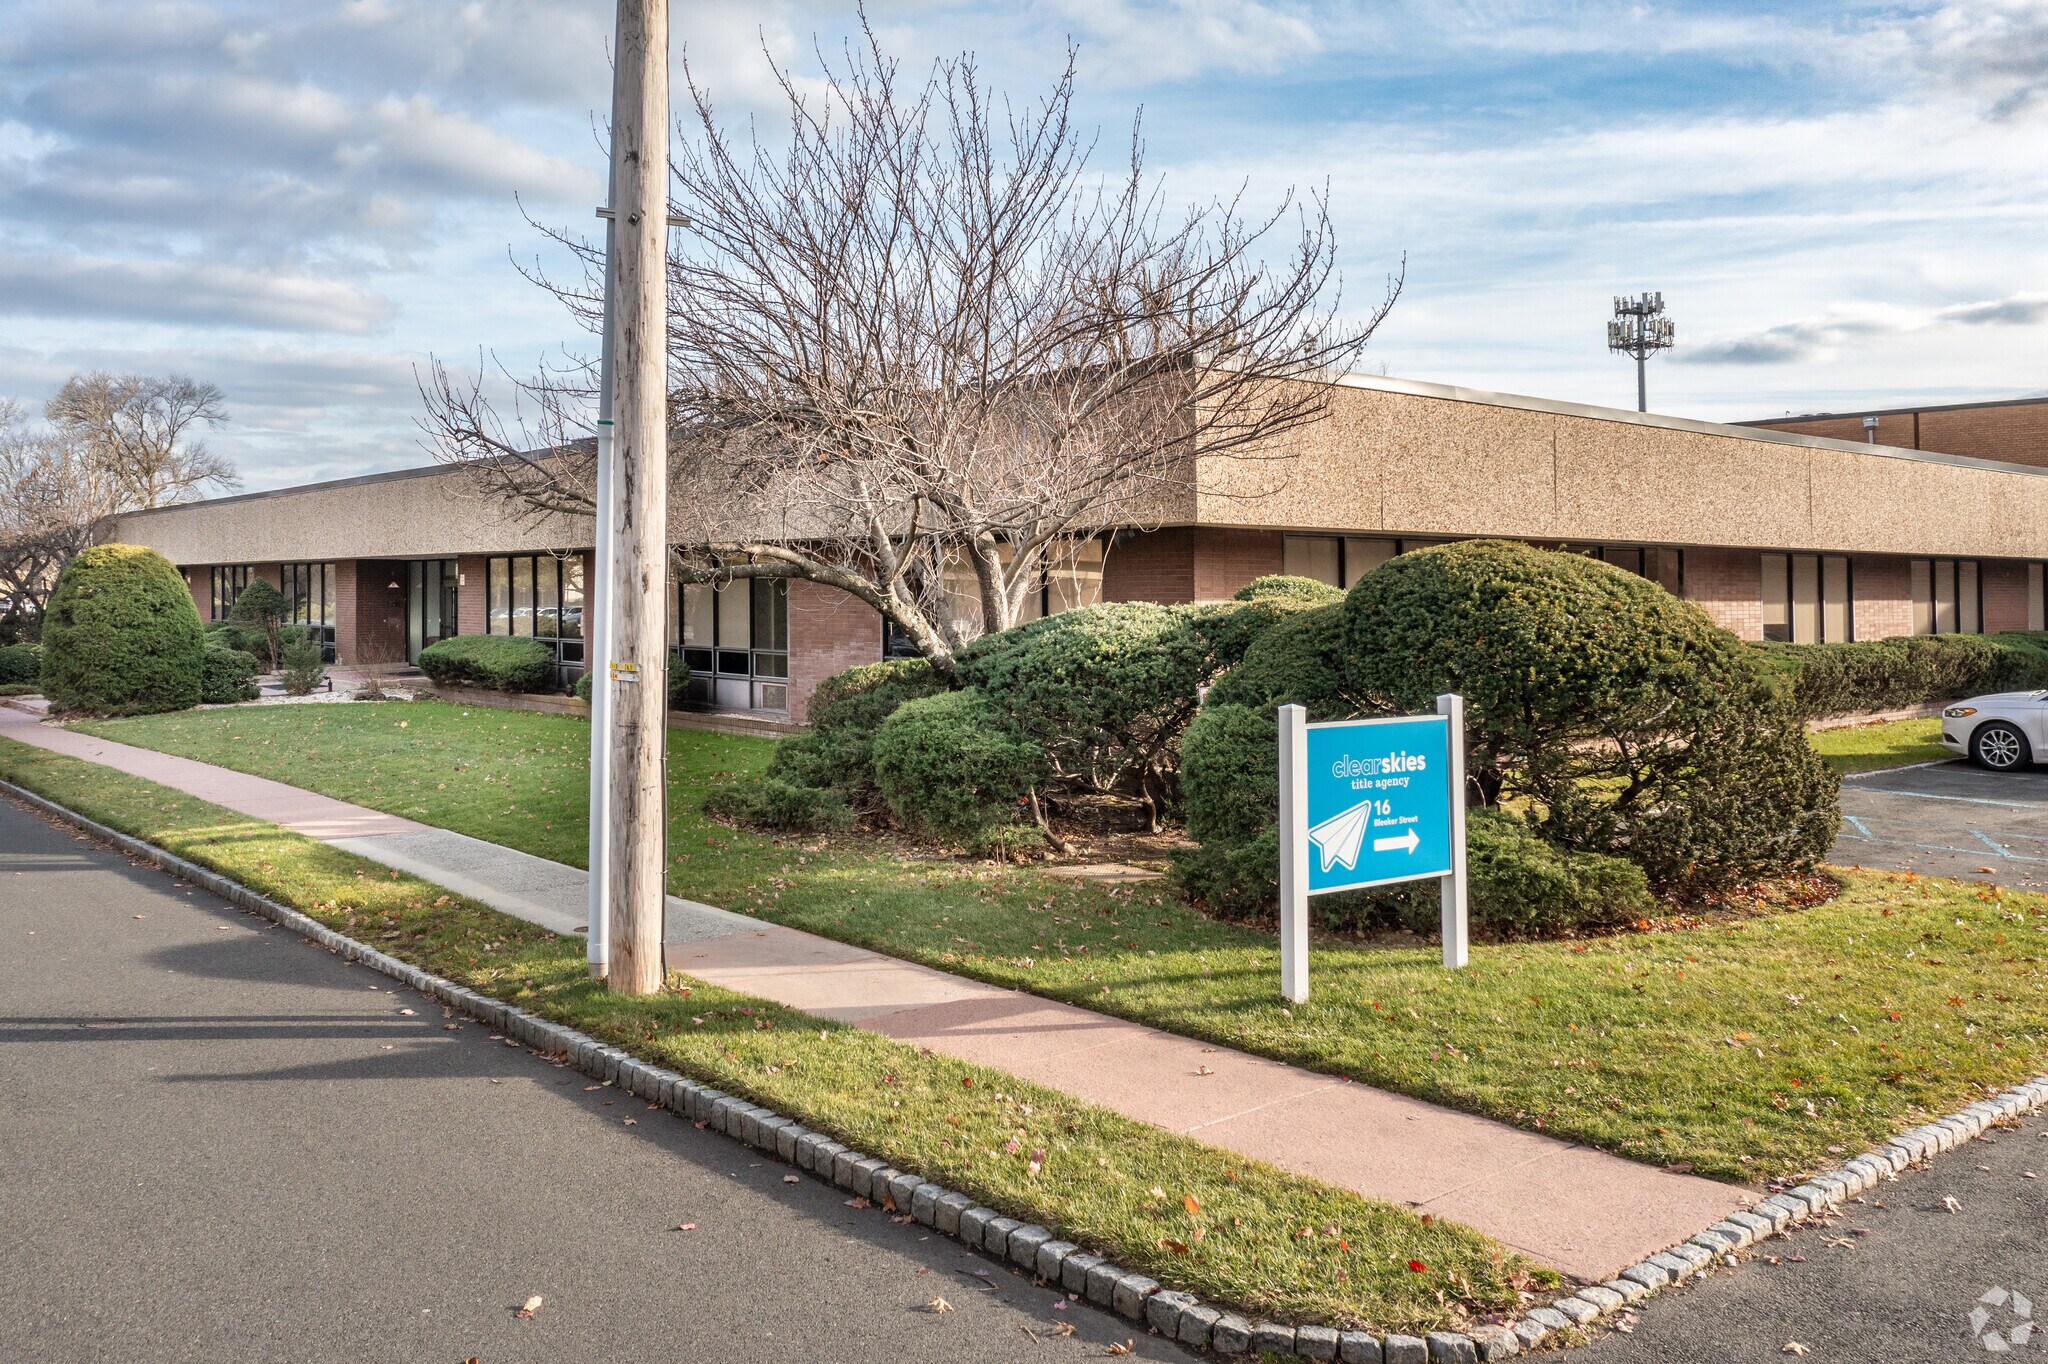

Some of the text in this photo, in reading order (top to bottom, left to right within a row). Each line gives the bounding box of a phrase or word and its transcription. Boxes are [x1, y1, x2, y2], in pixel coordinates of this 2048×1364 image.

[1332, 750, 1426, 778] clearskies
[1351, 776, 1410, 790] title agency
[1374, 799, 1391, 815] 16
[1373, 815, 1418, 827] Bleeker Street
